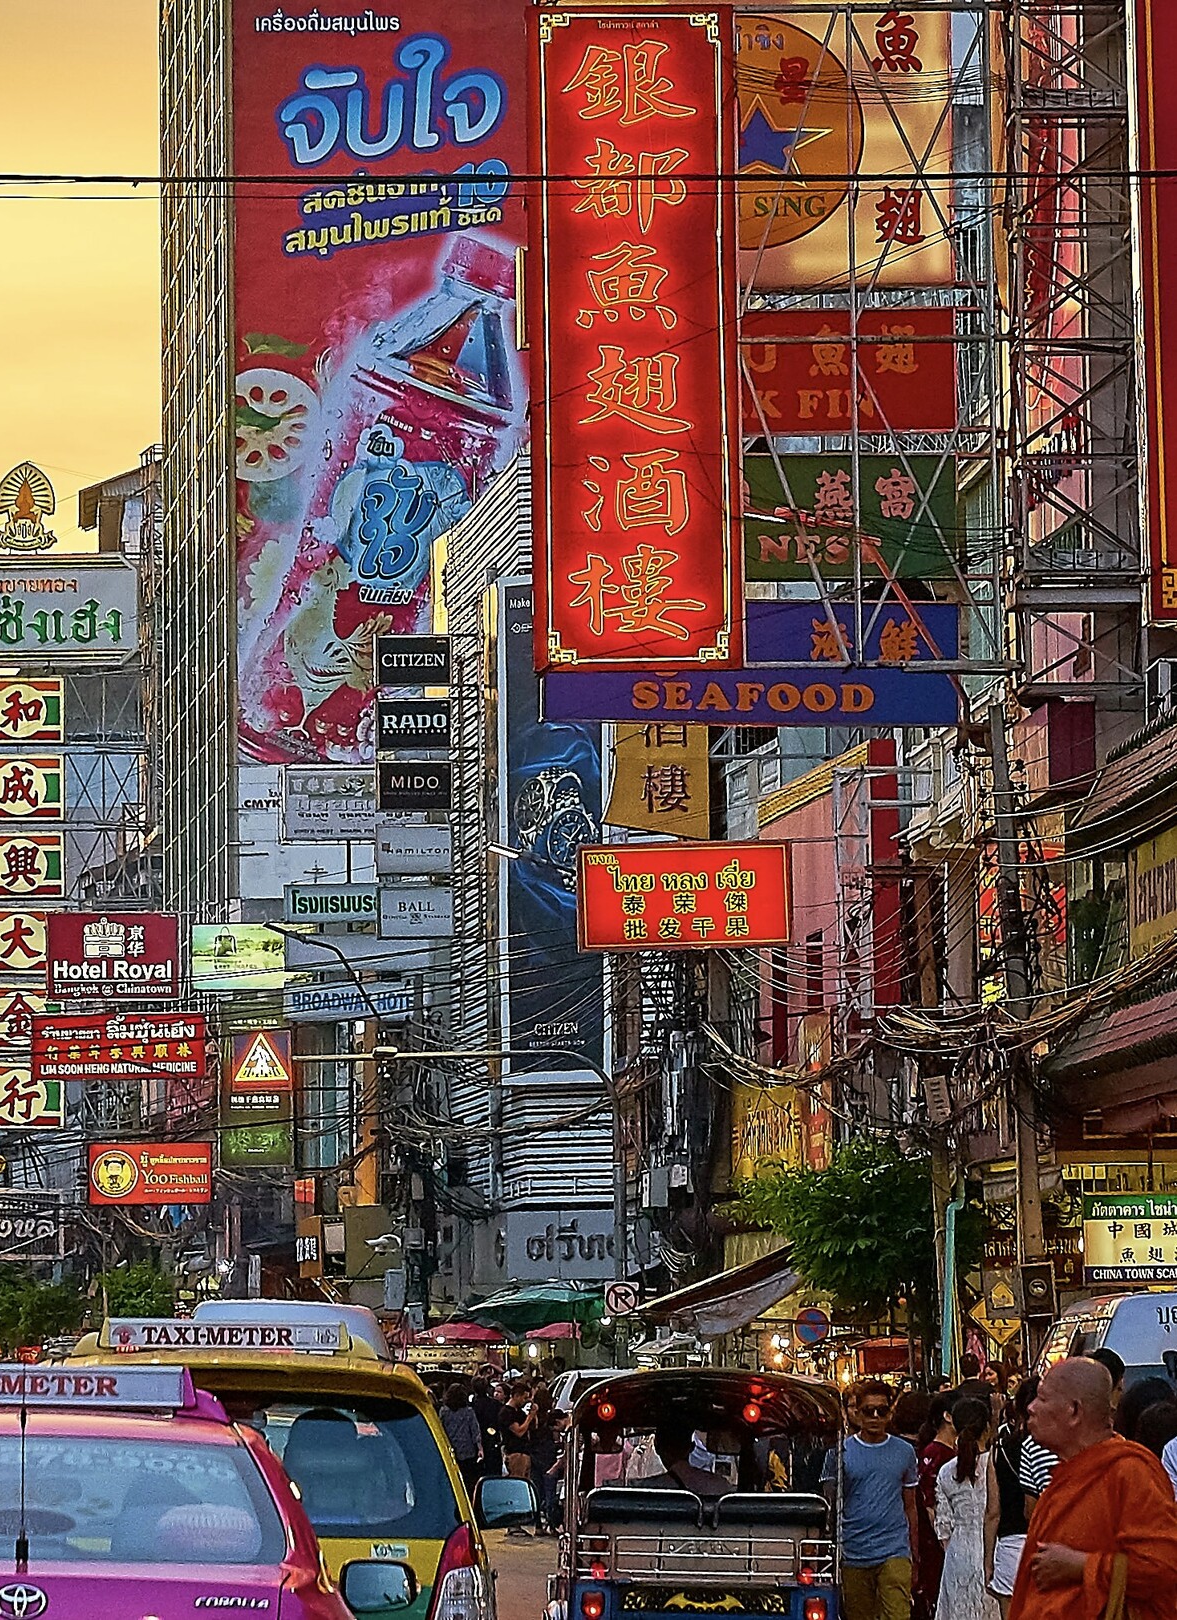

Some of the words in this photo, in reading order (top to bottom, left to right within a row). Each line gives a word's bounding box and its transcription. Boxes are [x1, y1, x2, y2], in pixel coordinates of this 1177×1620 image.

[255, 10, 400, 36] เครื่องดื่มสมุนไพร
[281, 38, 501, 164] จับใจ
[871, 11, 926, 246] 魚翅
[451, 158, 510, 208] 10
[753, 193, 828, 218] SING
[562, 40, 706, 641] 銀都魚翅酒樓
[381, 653, 446, 668] CITIZEN
[631, 680, 876, 713] SEAFOOD
[382, 714, 448, 729] RADO
[391, 775, 439, 789] MIDO
[607, 865, 656, 892] ไทย
[661, 872, 709, 891] หลง
[715, 858, 756, 889] เจี่ย
[291, 889, 377, 915] โรงแรมบร
[398, 901, 435, 912] BALL
[53, 960, 107, 979] Hotel
[113, 960, 172, 982] Royal
[116, 984, 172, 994] Chinatown
[377, 991, 414, 1011] HOTE
[58, 1063, 83, 1075] SOON
[84, 1063, 110, 1074] HENG
[169, 1174, 208, 1184] Fishball
[1091, 1201, 1145, 1217] ภัตตาคาร
[1119, 1247, 1177, 1264] 魚翅
[1093, 1268, 1122, 1280] CHINA
[1124, 1267, 1153, 1279] TOWN
[141, 1326, 294, 1346] TAXI-METER
